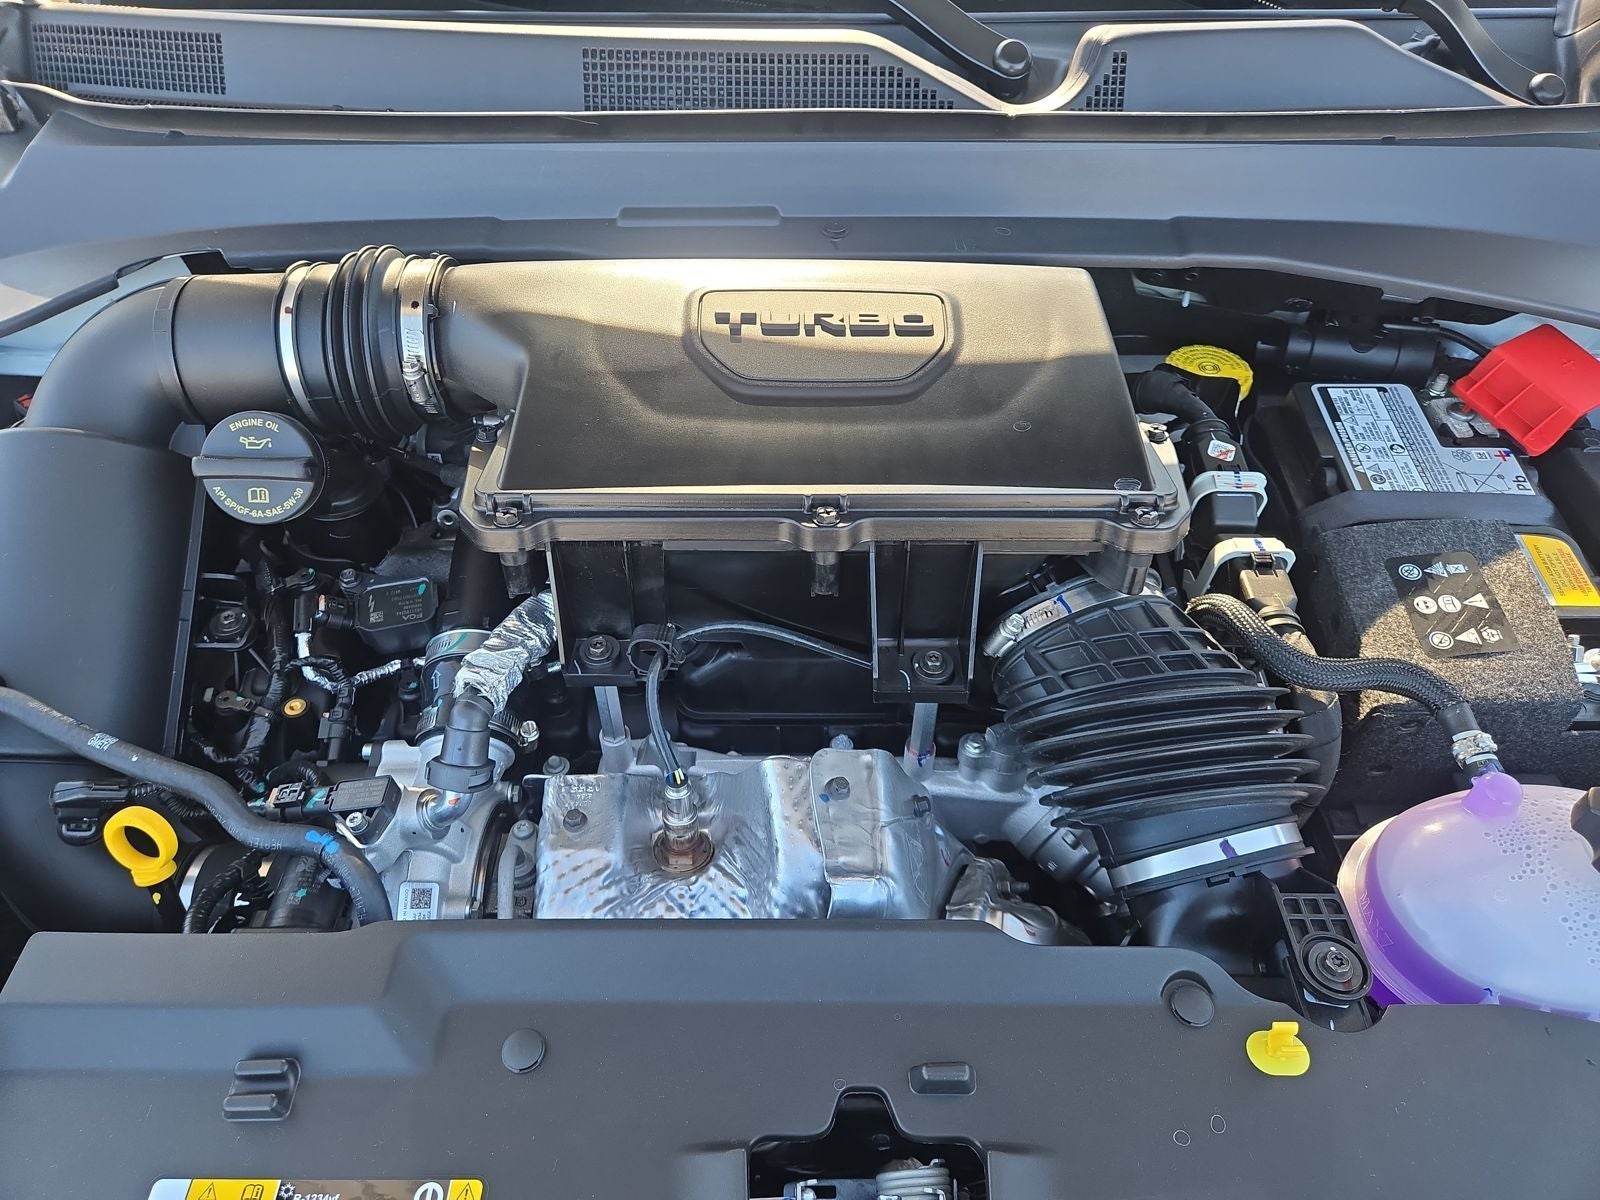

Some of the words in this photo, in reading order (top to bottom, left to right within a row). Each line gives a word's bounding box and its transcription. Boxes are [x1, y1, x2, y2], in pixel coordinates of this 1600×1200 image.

[714, 311, 935, 339] TURBO
[228, 418, 264, 432] ENGINE
[265, 420, 280, 433] OIL
[1512, 475, 1532, 491] Pb
[212, 486, 227, 500] API
